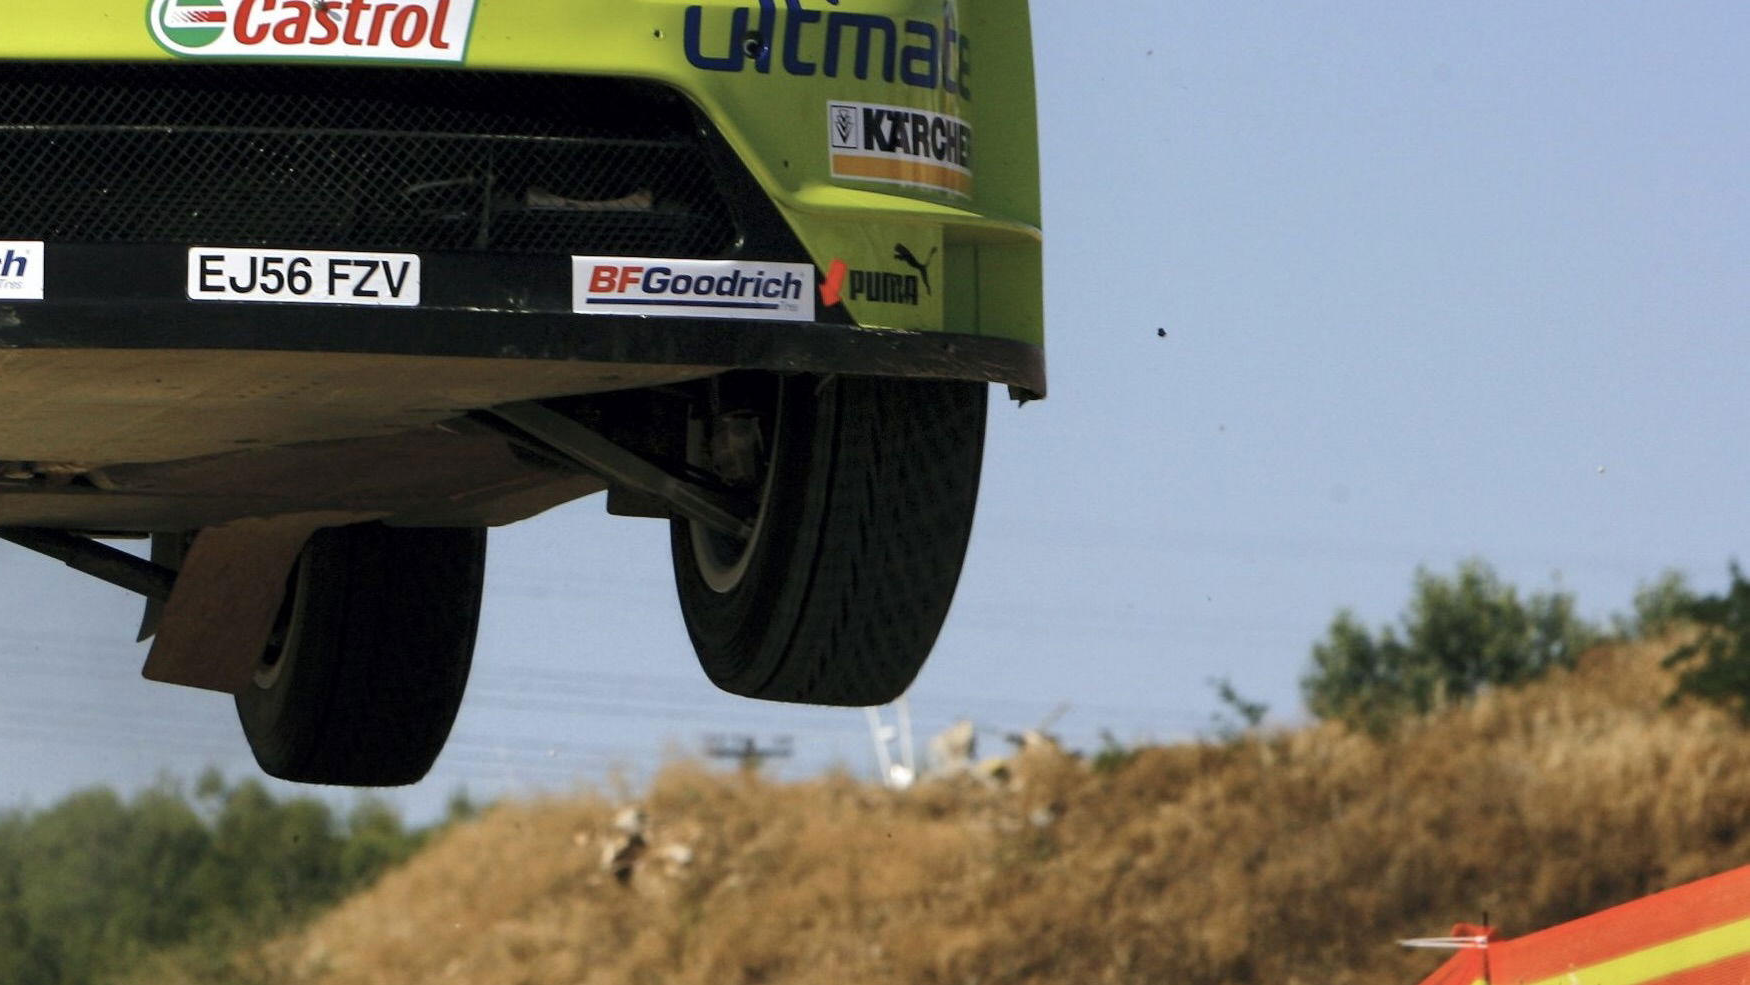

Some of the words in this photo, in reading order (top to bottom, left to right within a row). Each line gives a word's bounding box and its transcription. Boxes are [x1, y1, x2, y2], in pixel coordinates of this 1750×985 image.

[862, 107, 971, 167] KÄRCHE
[199, 255, 313, 296] EJ56
[328, 259, 411, 299] FZV
[588, 265, 803, 300] BFGoodrich
[850, 269, 919, 306] PUMA
